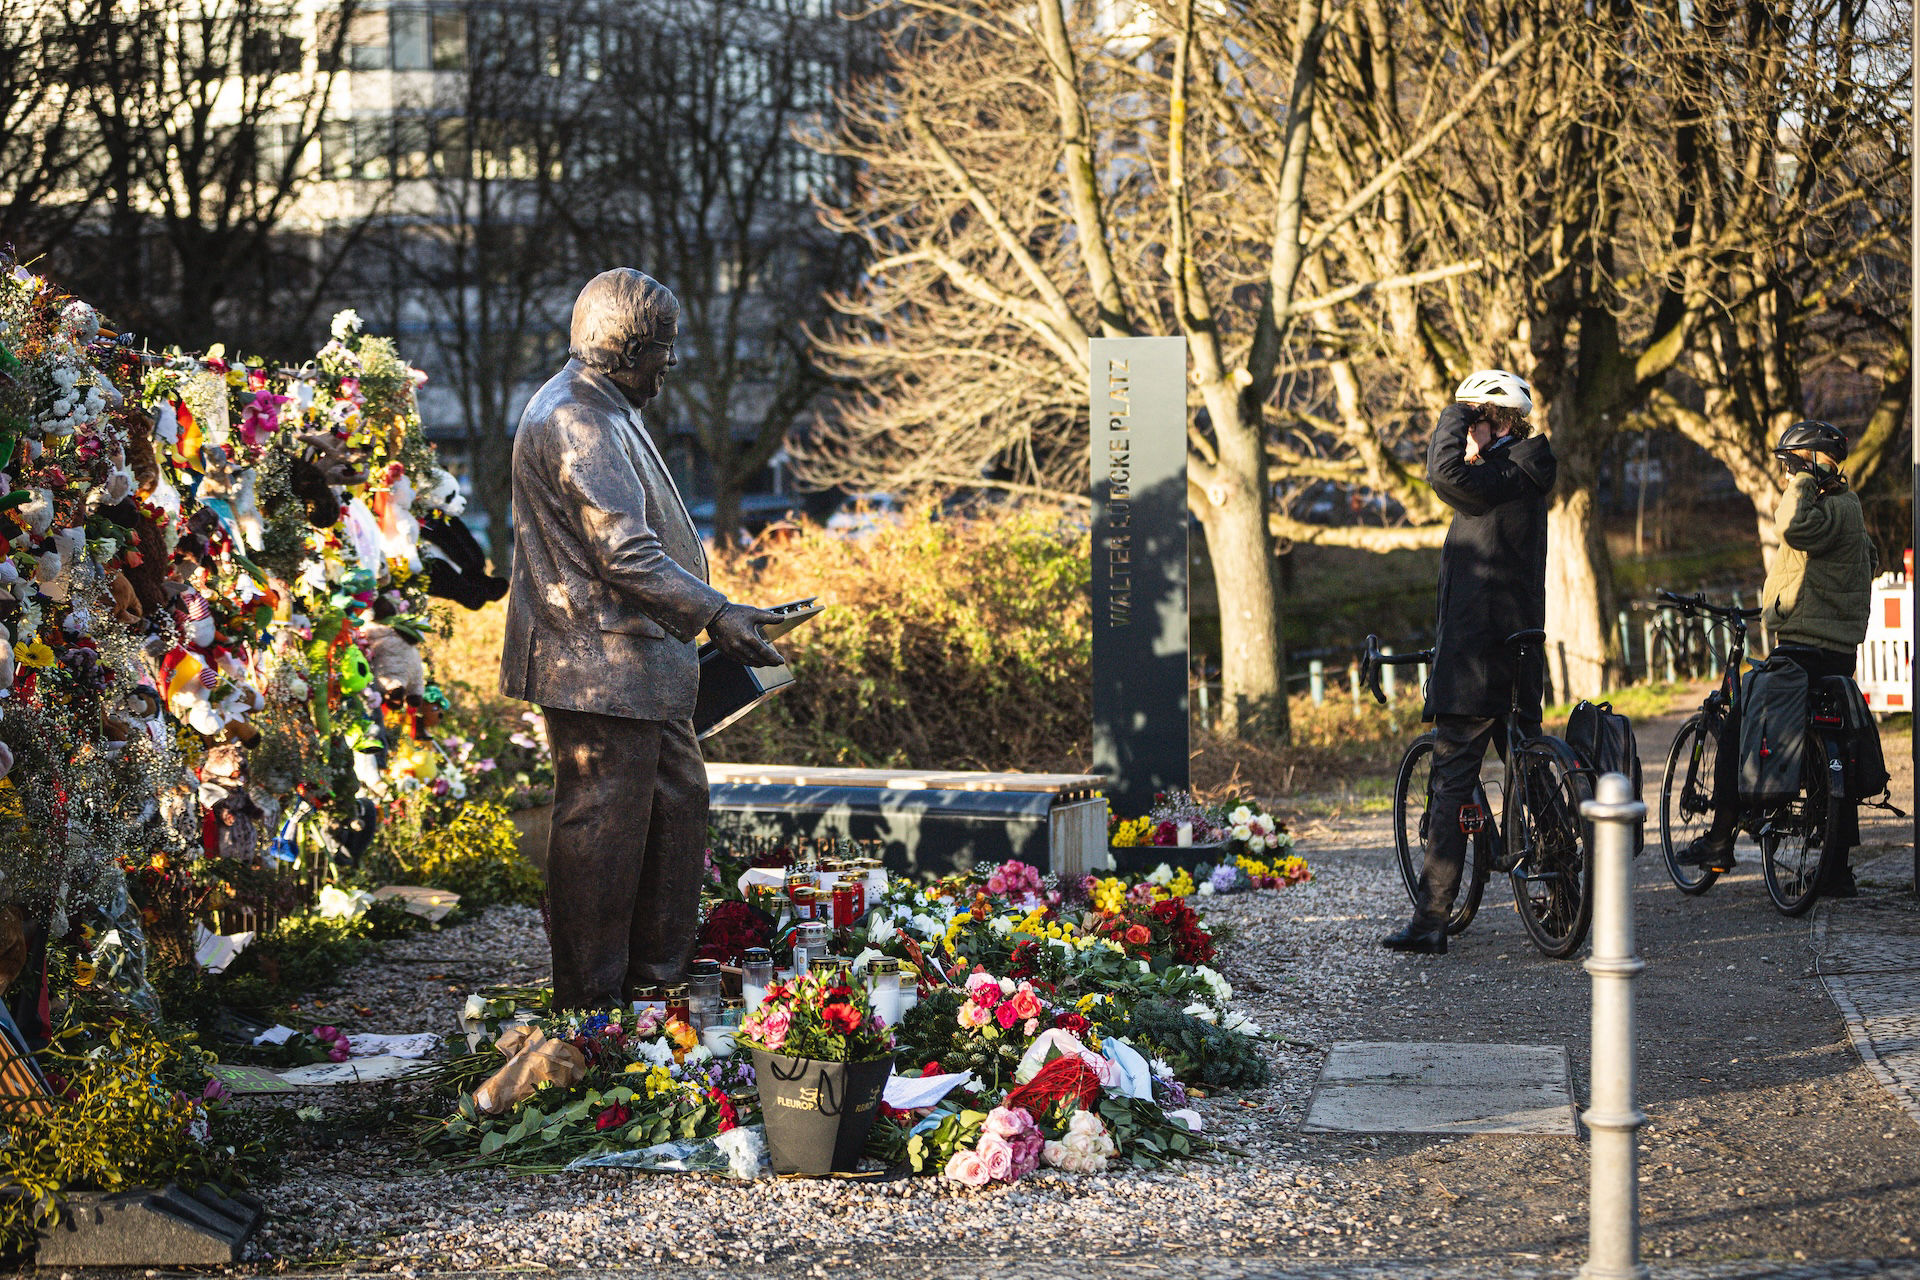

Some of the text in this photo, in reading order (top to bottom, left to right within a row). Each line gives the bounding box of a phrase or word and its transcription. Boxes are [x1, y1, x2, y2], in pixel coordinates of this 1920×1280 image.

[1106, 358, 1131, 627] WALTER LÜBCKE PLATZ
[777, 1096, 815, 1111] FLEUROP
